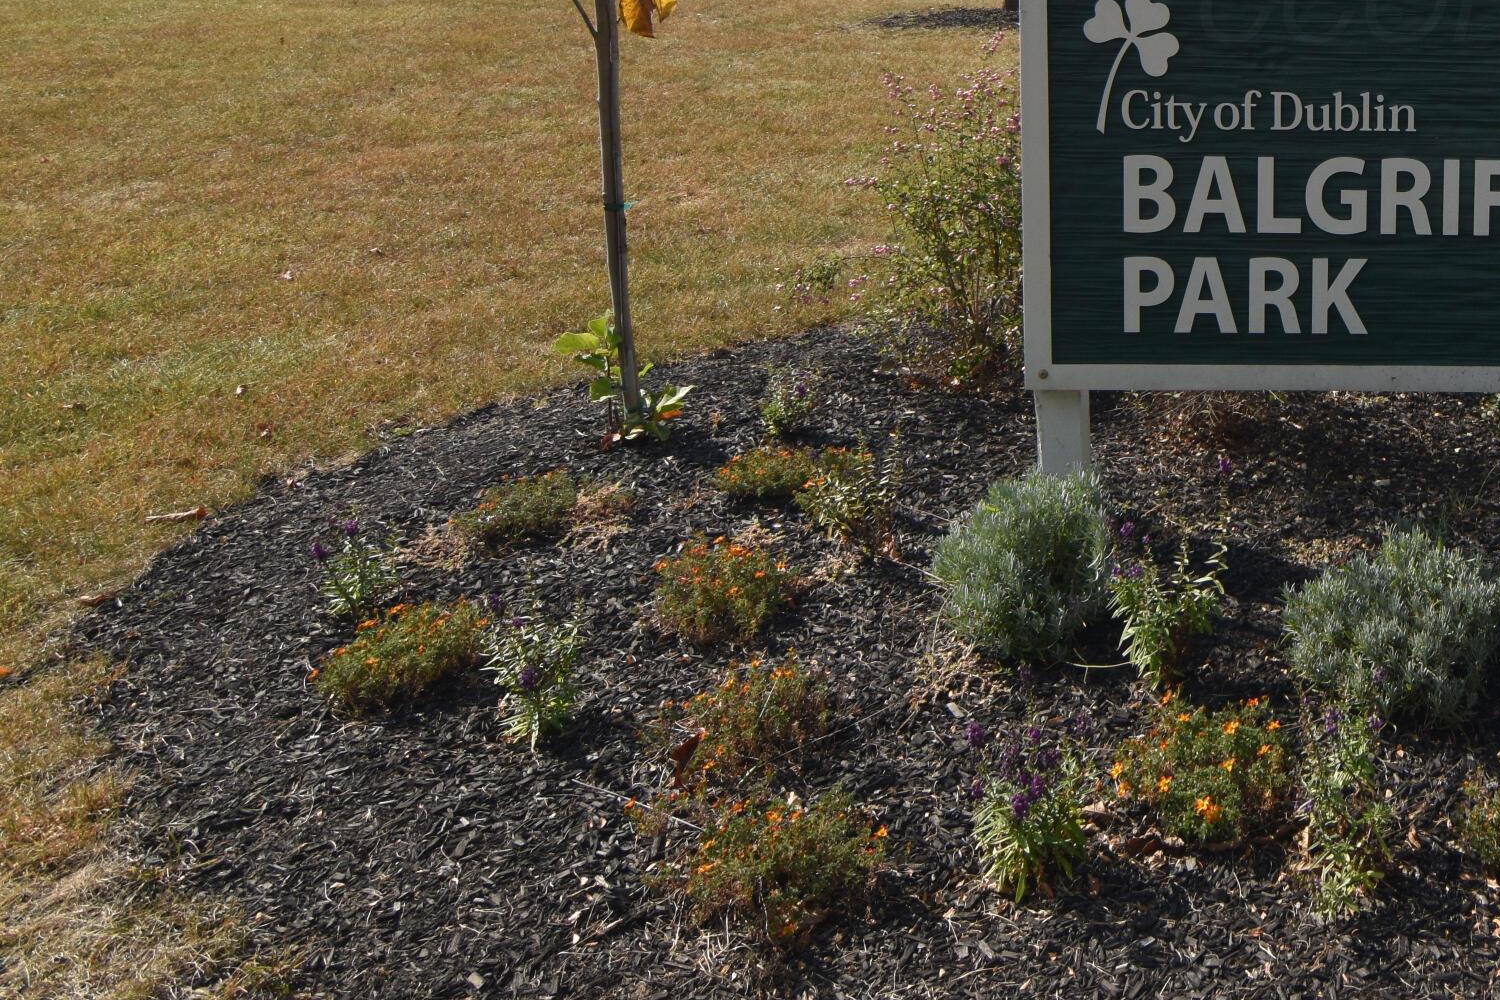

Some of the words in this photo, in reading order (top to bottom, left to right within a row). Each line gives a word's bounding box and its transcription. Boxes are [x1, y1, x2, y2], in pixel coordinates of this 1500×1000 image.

[1121, 89, 1208, 143] City
[1213, 90, 1262, 131] of
[1270, 91, 1417, 132] Dublin
[1123, 256, 1368, 335] PARK
